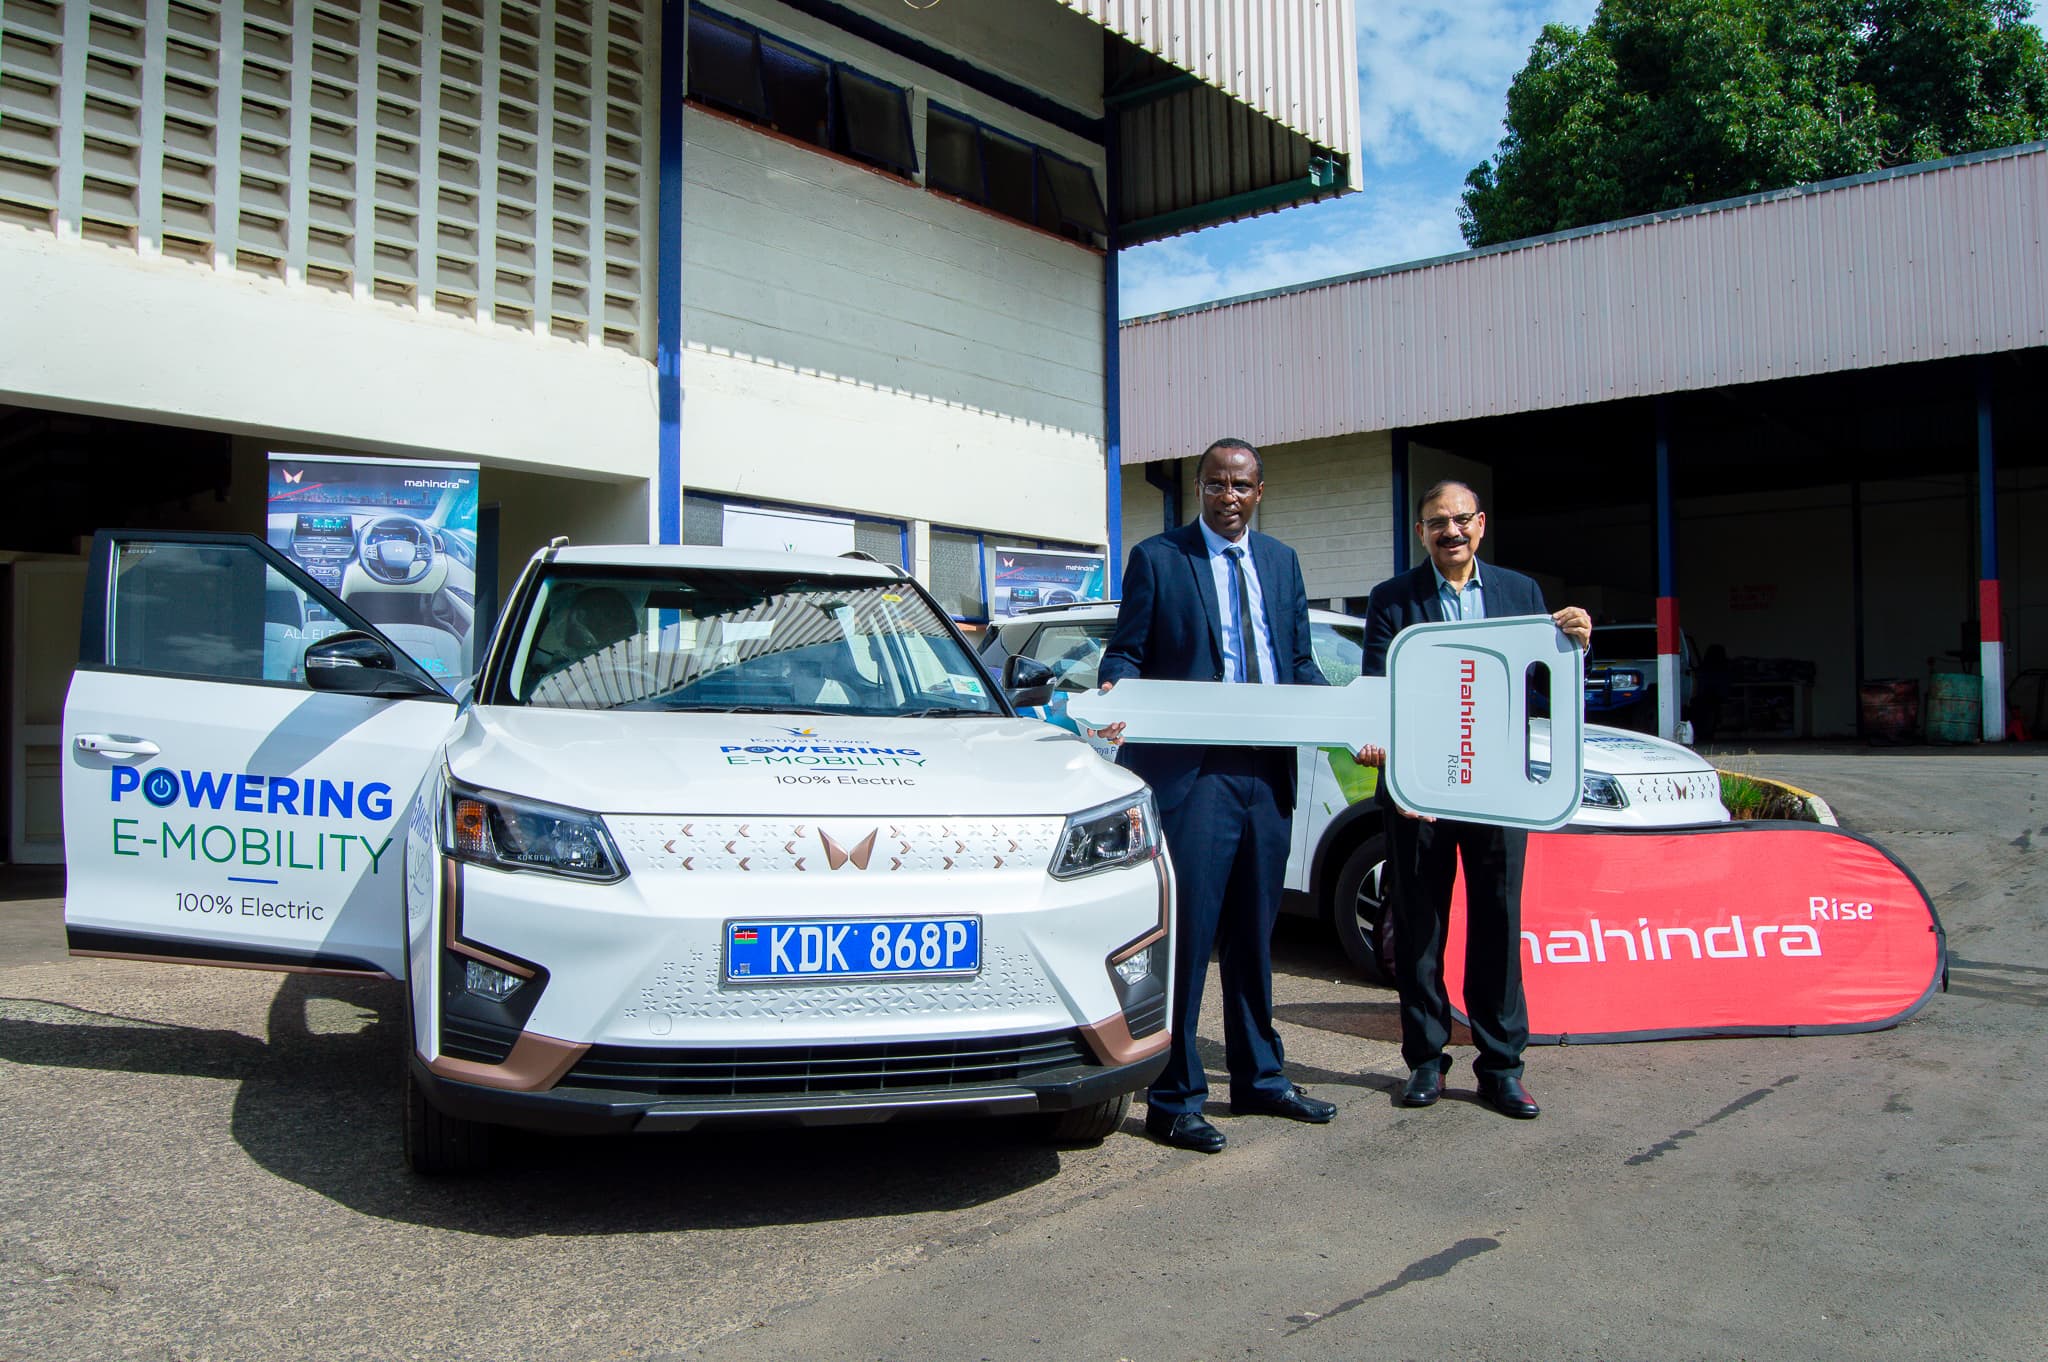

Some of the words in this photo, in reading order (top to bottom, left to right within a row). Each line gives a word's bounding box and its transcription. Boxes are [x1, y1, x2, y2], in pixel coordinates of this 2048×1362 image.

[404, 479, 460, 489] mahindra
[283, 628, 310, 640] ALL
[1460, 659, 1476, 784] mahindra
[720, 746, 921, 756] POWERING
[726, 755, 928, 767] E-MOBILITY
[774, 775, 831, 785] 100%
[837, 776, 916, 786] Electric
[1447, 754, 1459, 787] Rise.
[110, 765, 394, 821] POWERING
[112, 817, 394, 874] E-MOBILITY
[175, 892, 233, 915] 100%
[240, 896, 325, 921] Electric
[1808, 896, 1874, 921] Rise
[770, 925, 850, 973] KDK
[869, 922, 968, 970] 868P
